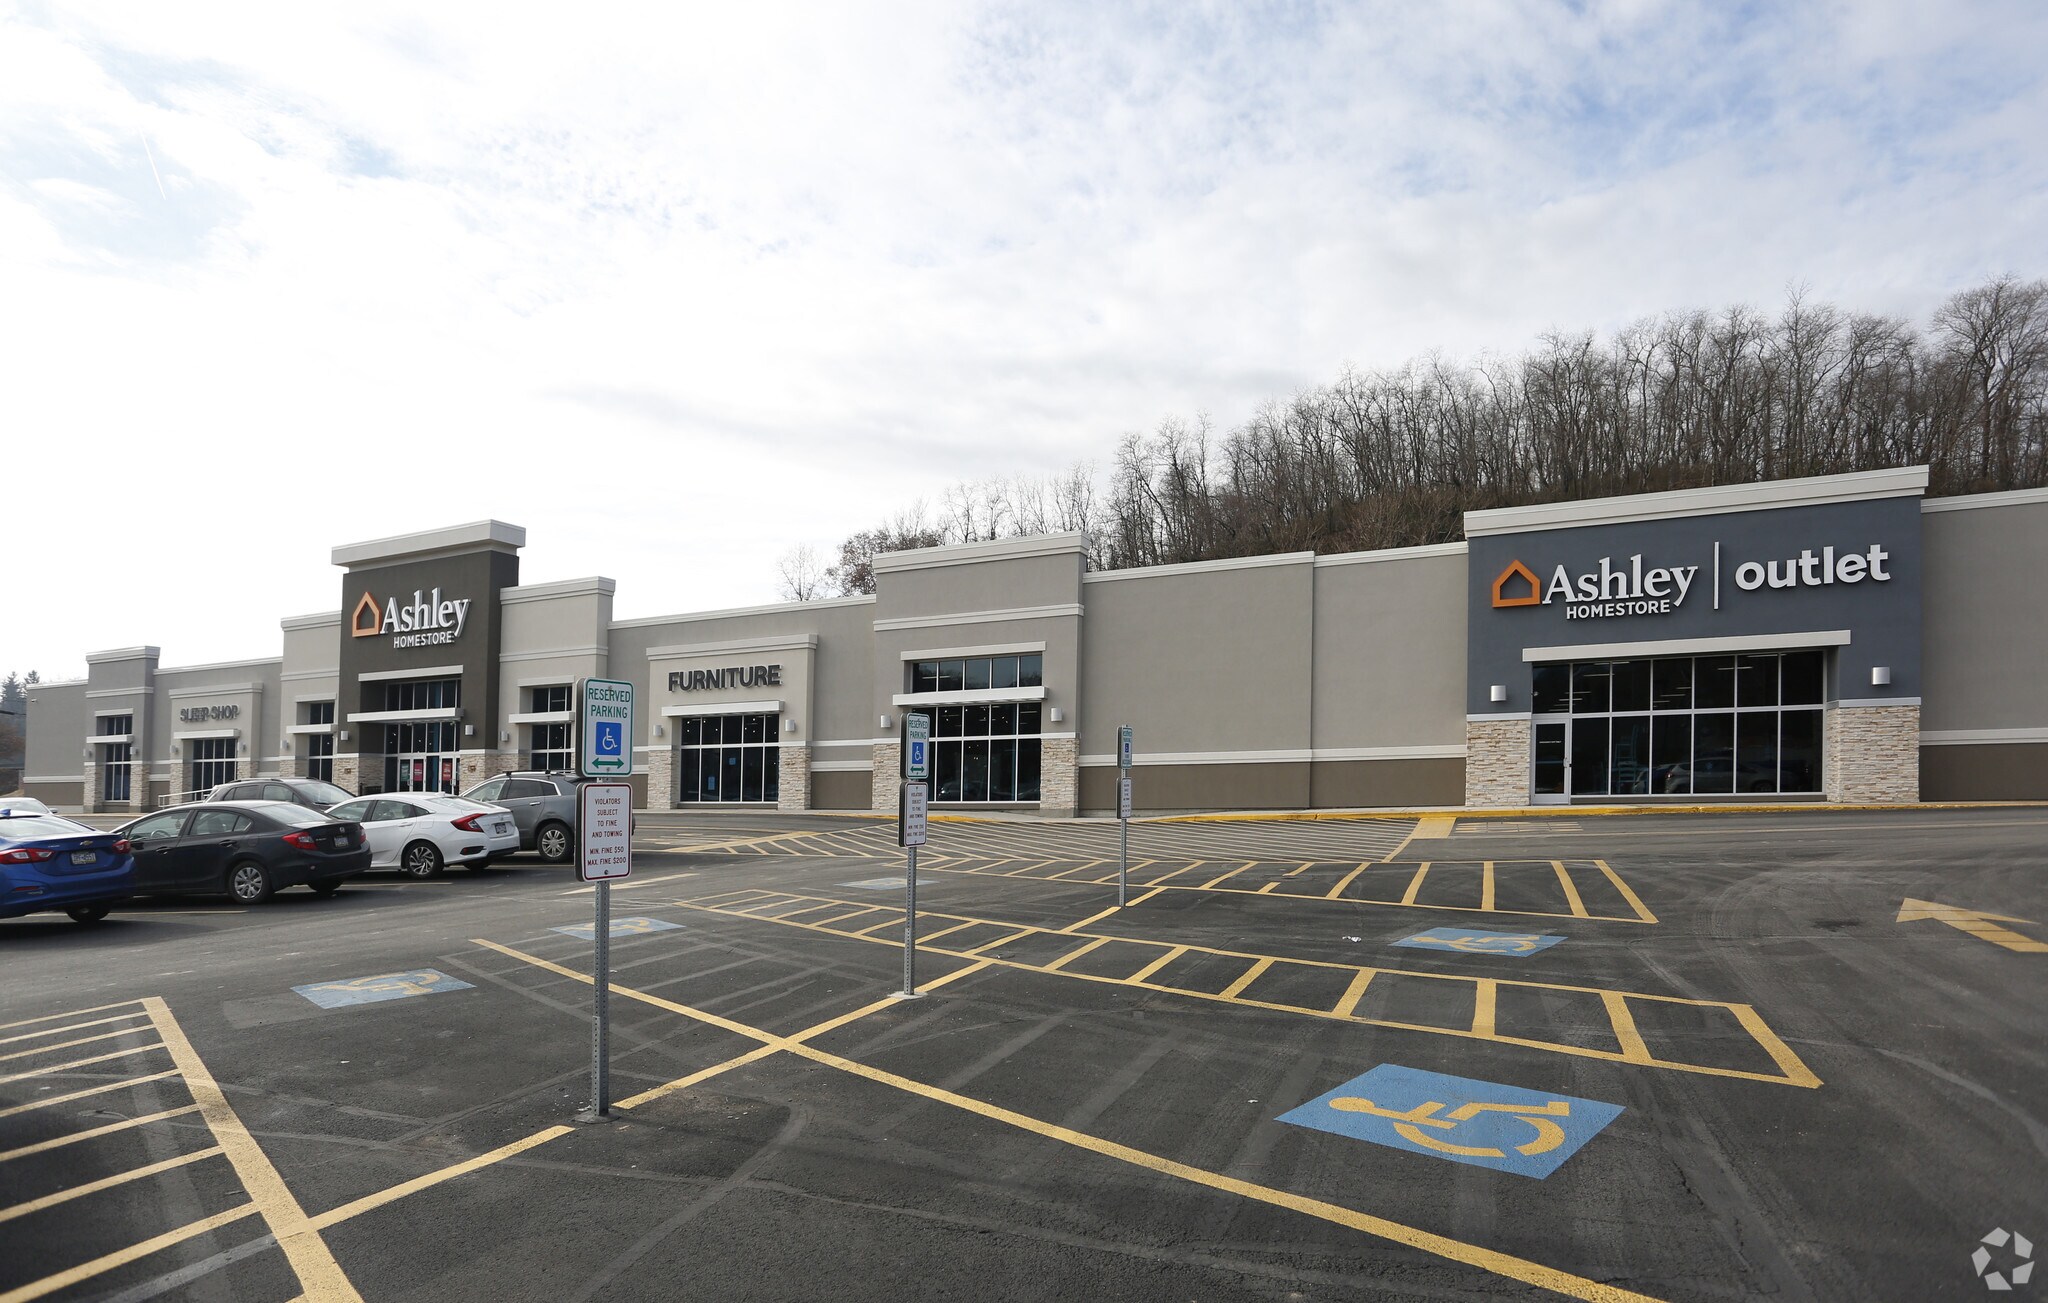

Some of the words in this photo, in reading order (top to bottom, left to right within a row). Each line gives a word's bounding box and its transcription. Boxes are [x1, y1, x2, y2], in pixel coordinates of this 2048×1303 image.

[1542, 553, 1698, 607] Ashley
[1735, 544, 1891, 591] outlet
[380, 587, 471, 637] Ashley
[1566, 599, 1670, 619] HOMESTORE
[393, 631, 455, 649] HOMESTORE
[668, 664, 783, 692] FURNITURE
[588, 687, 631, 703] RESERVED
[180, 706, 210, 722] SLEEP
[211, 704, 240, 720] SHOP
[590, 704, 628, 719] PARKING
[908, 719, 929, 730] RESERVED
[910, 730, 927, 740] PARKING
[594, 797, 621, 805] VIOLATORS
[596, 808, 619, 816] SUBJECT
[605, 819, 618, 827] FINE
[592, 831, 603, 839] AND
[604, 830, 623, 838] TOWING
[613, 856, 627, 865] $200
